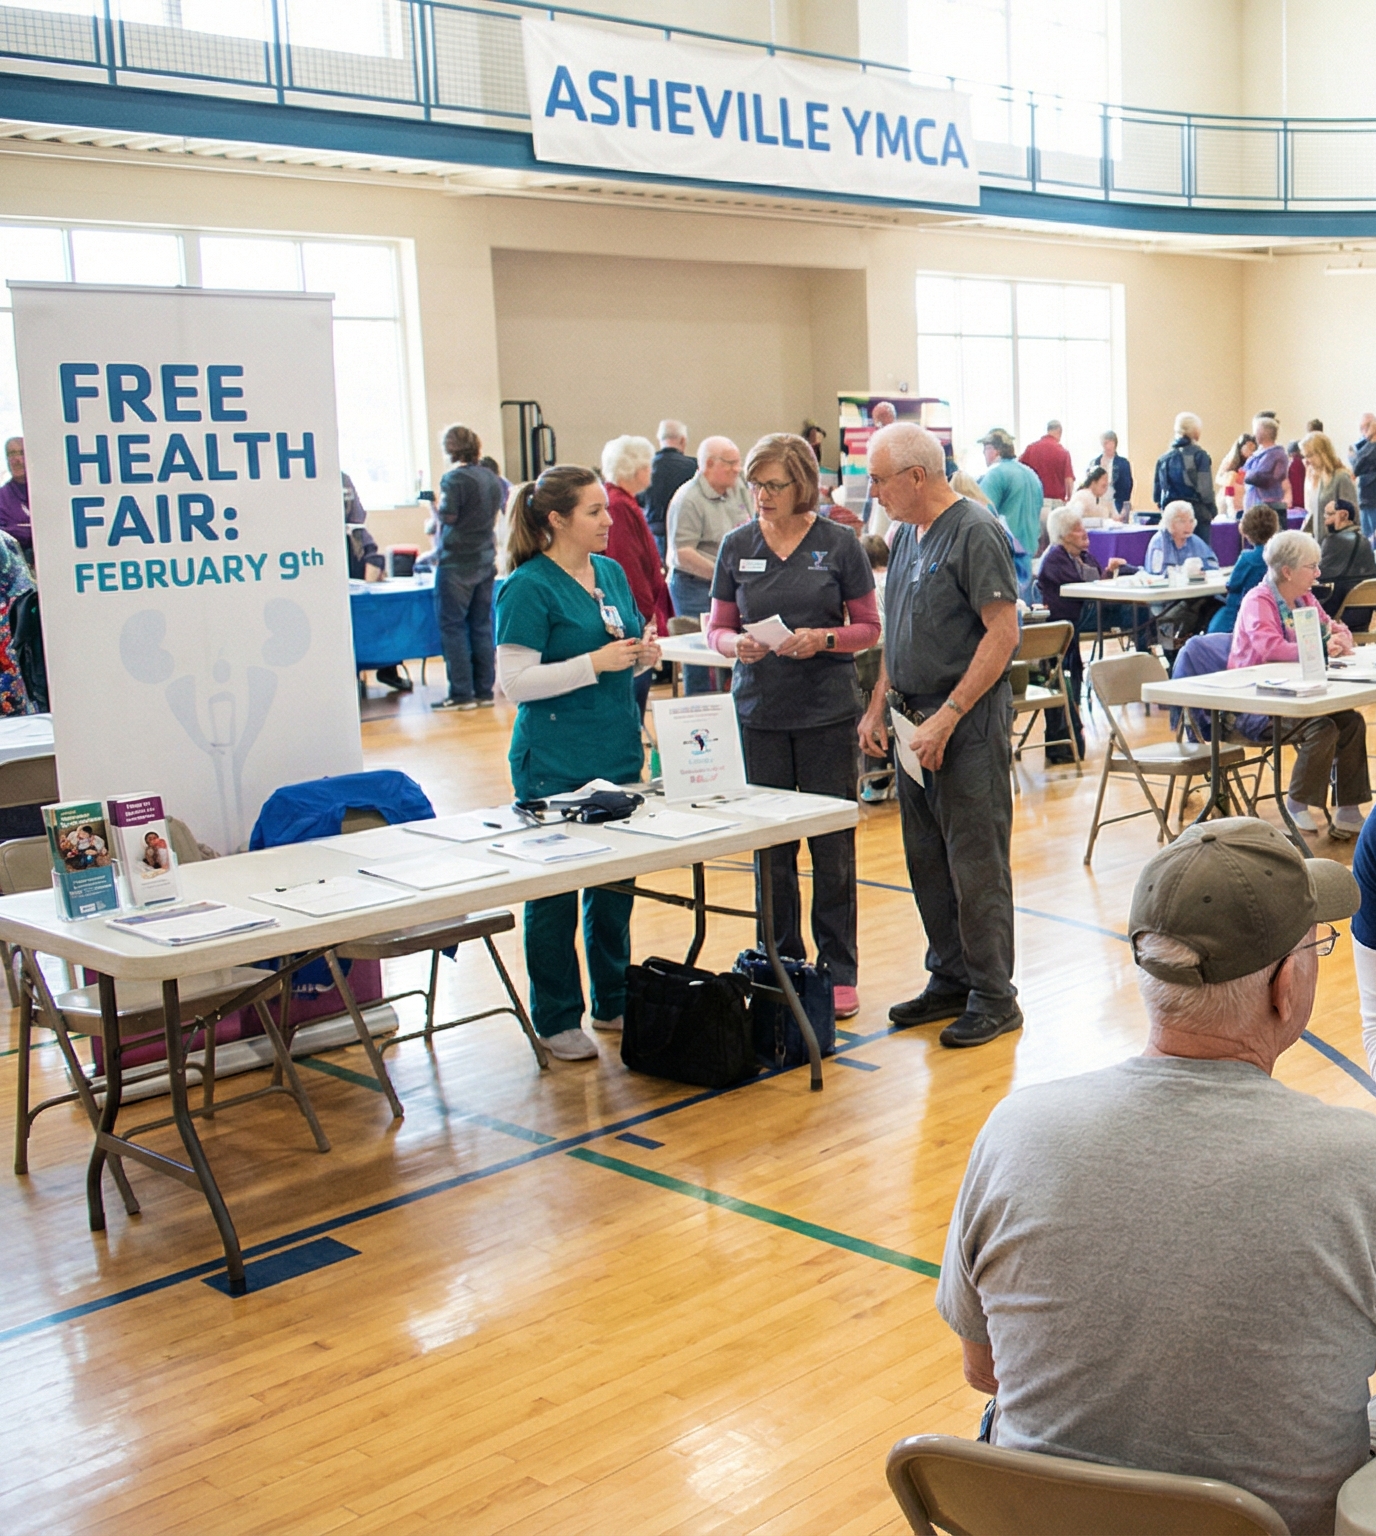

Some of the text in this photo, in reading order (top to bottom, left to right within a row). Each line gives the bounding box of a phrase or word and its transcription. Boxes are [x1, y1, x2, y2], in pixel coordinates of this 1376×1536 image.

[544, 64, 969, 169] ASHEVILLE YMCA
[59, 363, 248, 424] FREE
[64, 431, 317, 486] HEALTH
[70, 493, 239, 549] FAIR:
[74, 547, 324, 593] FEBRUARY 9th
